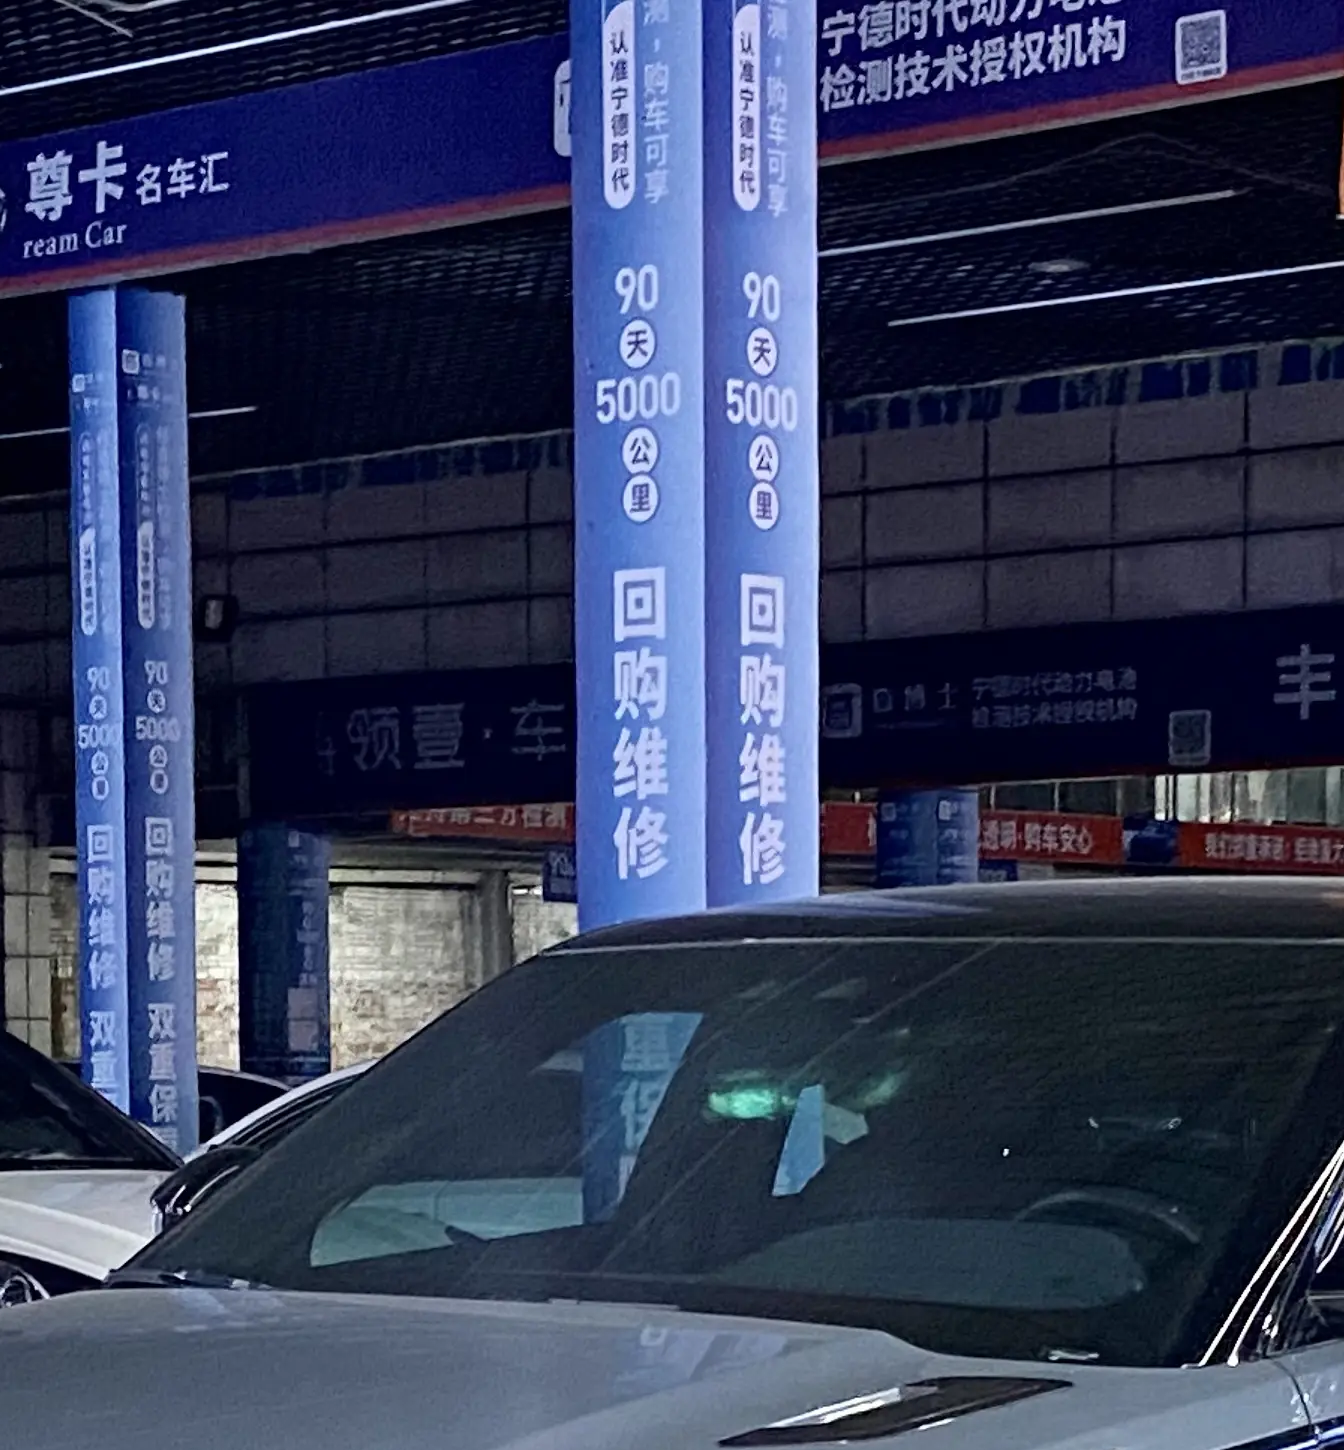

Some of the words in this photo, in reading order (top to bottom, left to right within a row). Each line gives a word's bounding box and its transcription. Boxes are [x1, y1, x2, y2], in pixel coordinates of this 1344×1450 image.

[822, 0, 1118, 56] 宁德时代动
[820, 15, 1126, 112] 检测技术授权机构
[609, 30, 630, 194] 认准宁德时代
[739, 31, 756, 195] 认准宁德时代
[24, 140, 127, 222] 尊卡
[135, 151, 230, 206] 名车汇
[84, 220, 127, 248] Car
[615, 264, 657, 315] 90
[743, 271, 780, 322] 90
[596, 372, 680, 424] 5000
[726, 379, 798, 432] 5000
[87, 667, 109, 691] 90
[144, 661, 168, 684] 90
[78, 724, 118, 749] 5000
[136, 716, 180, 742] 5000
[613, 566, 669, 880] 回购维修
[739, 573, 786, 885] 回购维修
[978, 819, 1093, 854] 透明·购车安心
[87, 824, 116, 990] 回购维修
[145, 816, 176, 981] 回购维修
